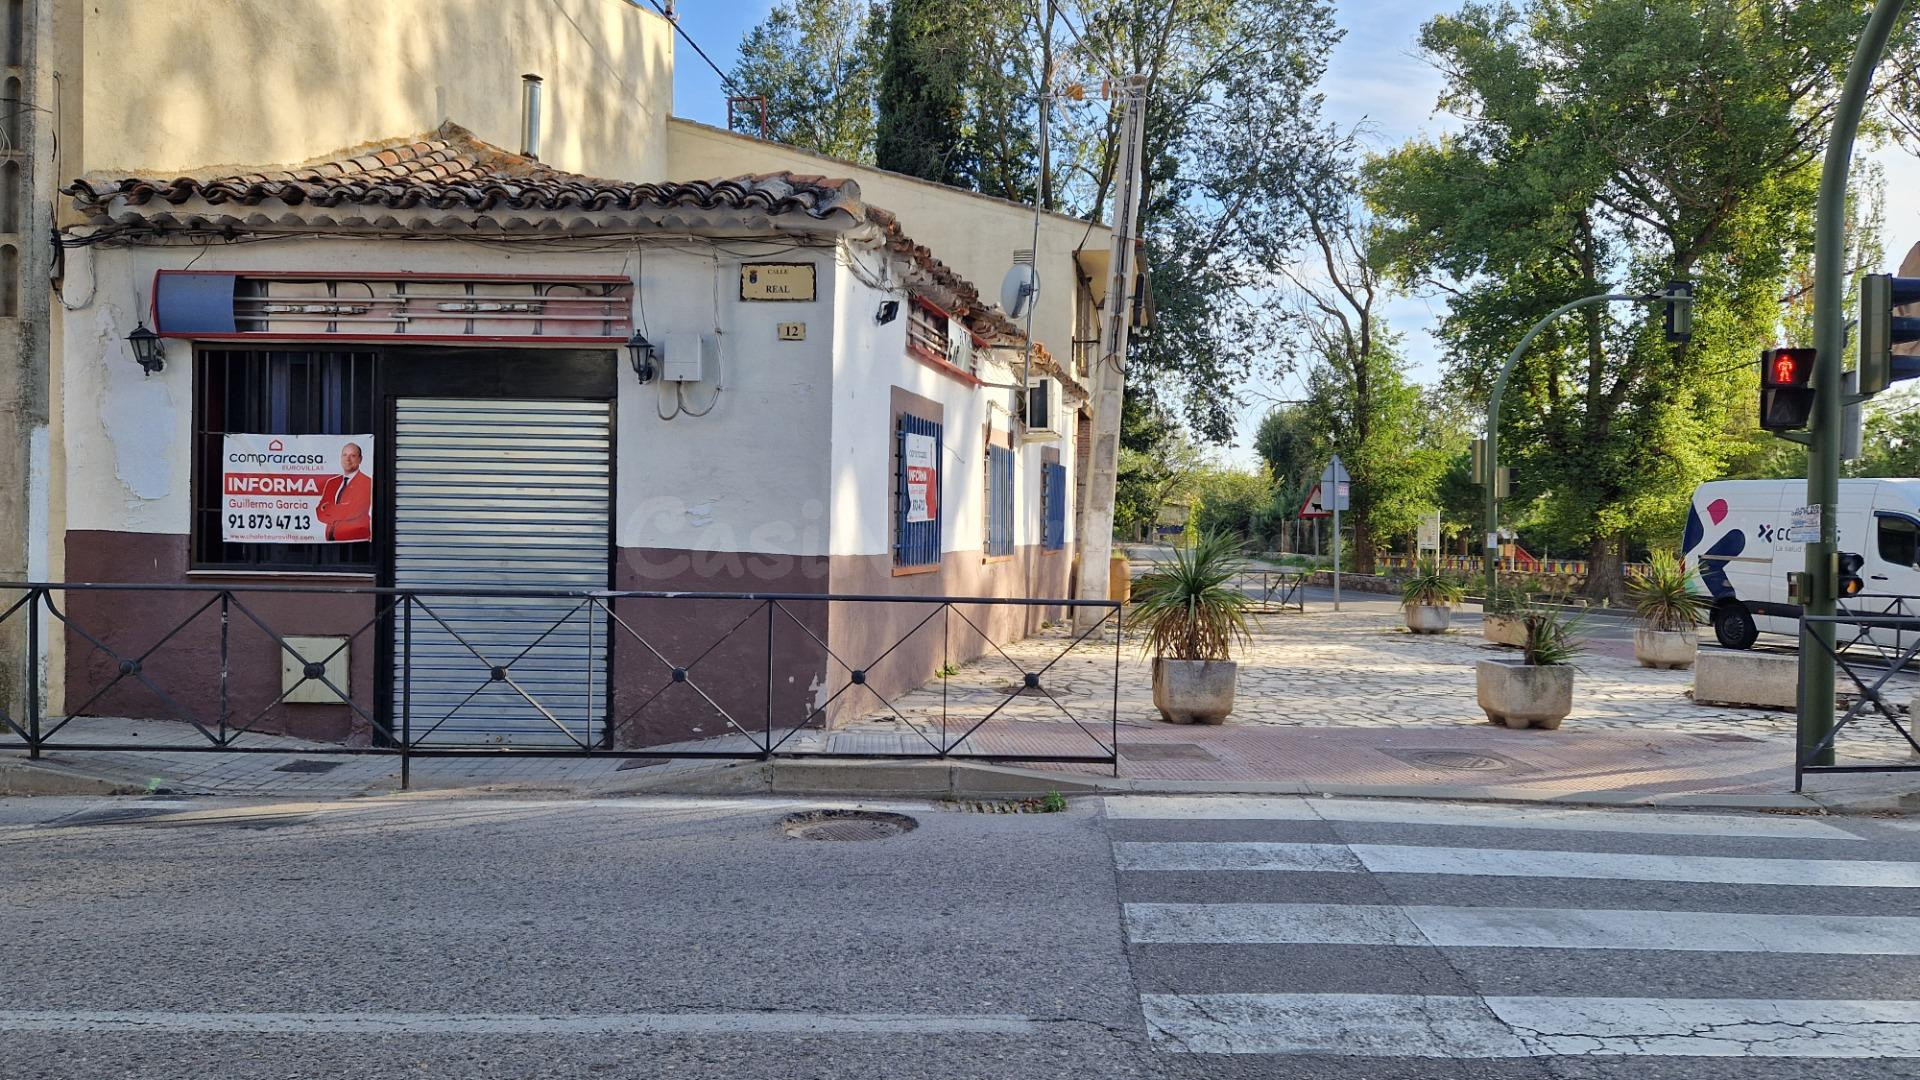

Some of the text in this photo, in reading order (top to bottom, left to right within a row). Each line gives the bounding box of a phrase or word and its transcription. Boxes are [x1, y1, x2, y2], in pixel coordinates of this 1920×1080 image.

[766, 285, 790, 294] REAL
[785, 326, 799, 337] 12
[229, 453, 323, 467] comprarcasa
[228, 478, 319, 492] INFORMA
[229, 499, 274, 509] Guillermo
[228, 514, 245, 529] 91
[248, 514, 273, 529] 873
